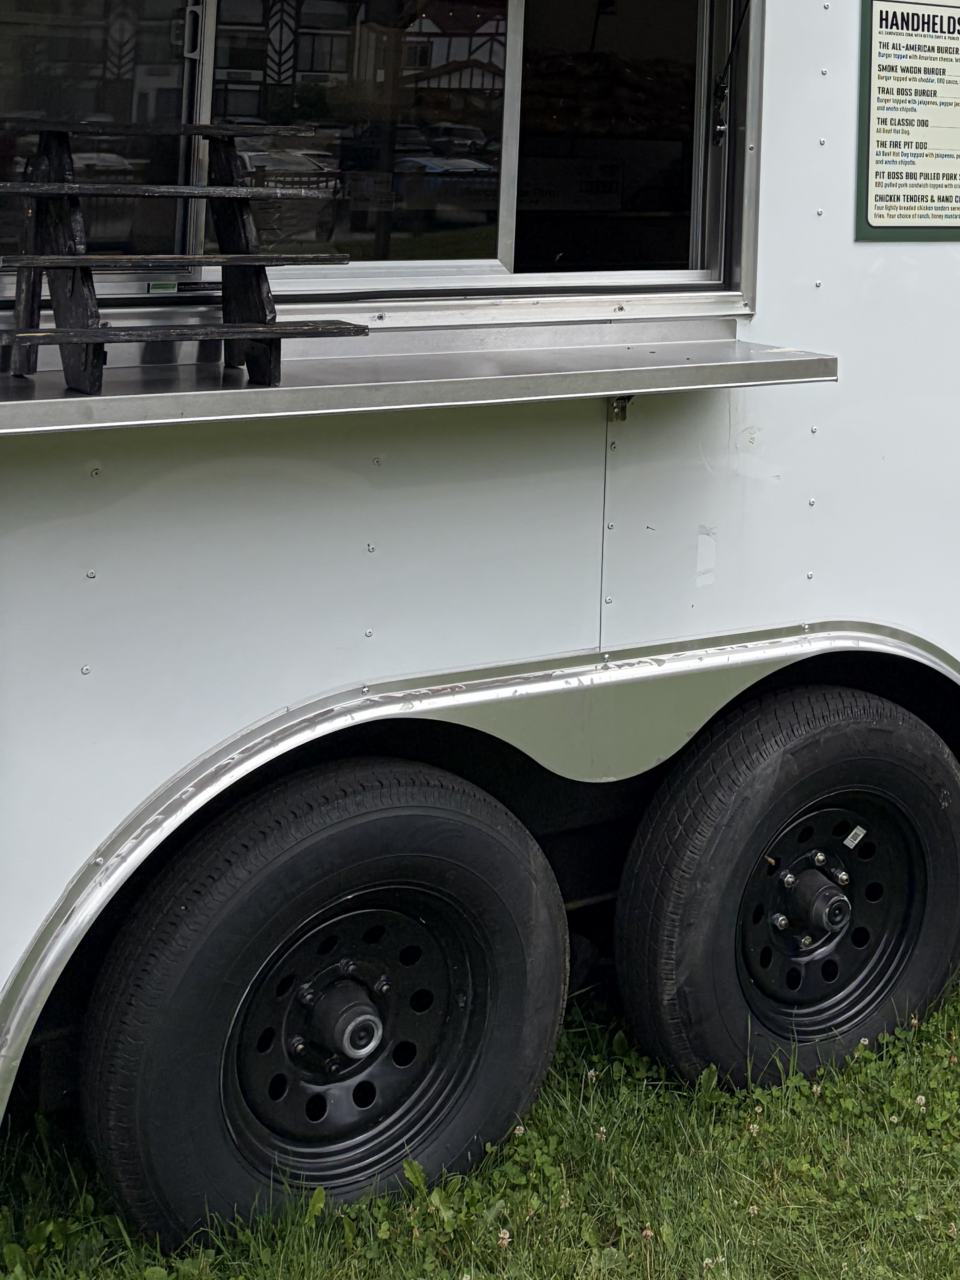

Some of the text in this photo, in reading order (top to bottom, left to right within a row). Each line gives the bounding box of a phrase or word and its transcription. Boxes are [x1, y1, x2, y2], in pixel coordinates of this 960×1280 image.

[878, 41, 890, 49] THE
[891, 42, 936, 53] ALL-AMERICAN
[936, 45, 960, 55] BURGER
[877, 63, 898, 72] SMOKE
[899, 65, 922, 74] WAGON
[923, 67, 947, 75] BURGER
[877, 86, 895, 95] TRAIL
[896, 87, 913, 96] BOSS
[914, 88, 938, 97] BURGER
[876, 117, 889, 125] THE
[889, 118, 915, 126] CLASSIC
[916, 119, 929, 127] DOG
[876, 140, 888, 148] THE
[889, 140, 902, 148] FIRE
[903, 141, 914, 149] PIT
[914, 141, 928, 149] DOG
[874, 171, 886, 179] PIT
[886, 171, 904, 179] BOSS
[904, 172, 918, 180] BBQ
[919, 172, 941, 180] PULLED
[941, 172, 958, 181] PORK
[874, 194, 901, 202] CHICKEN
[902, 194, 929, 202] TENDERS
[936, 195, 954, 203] HAND
